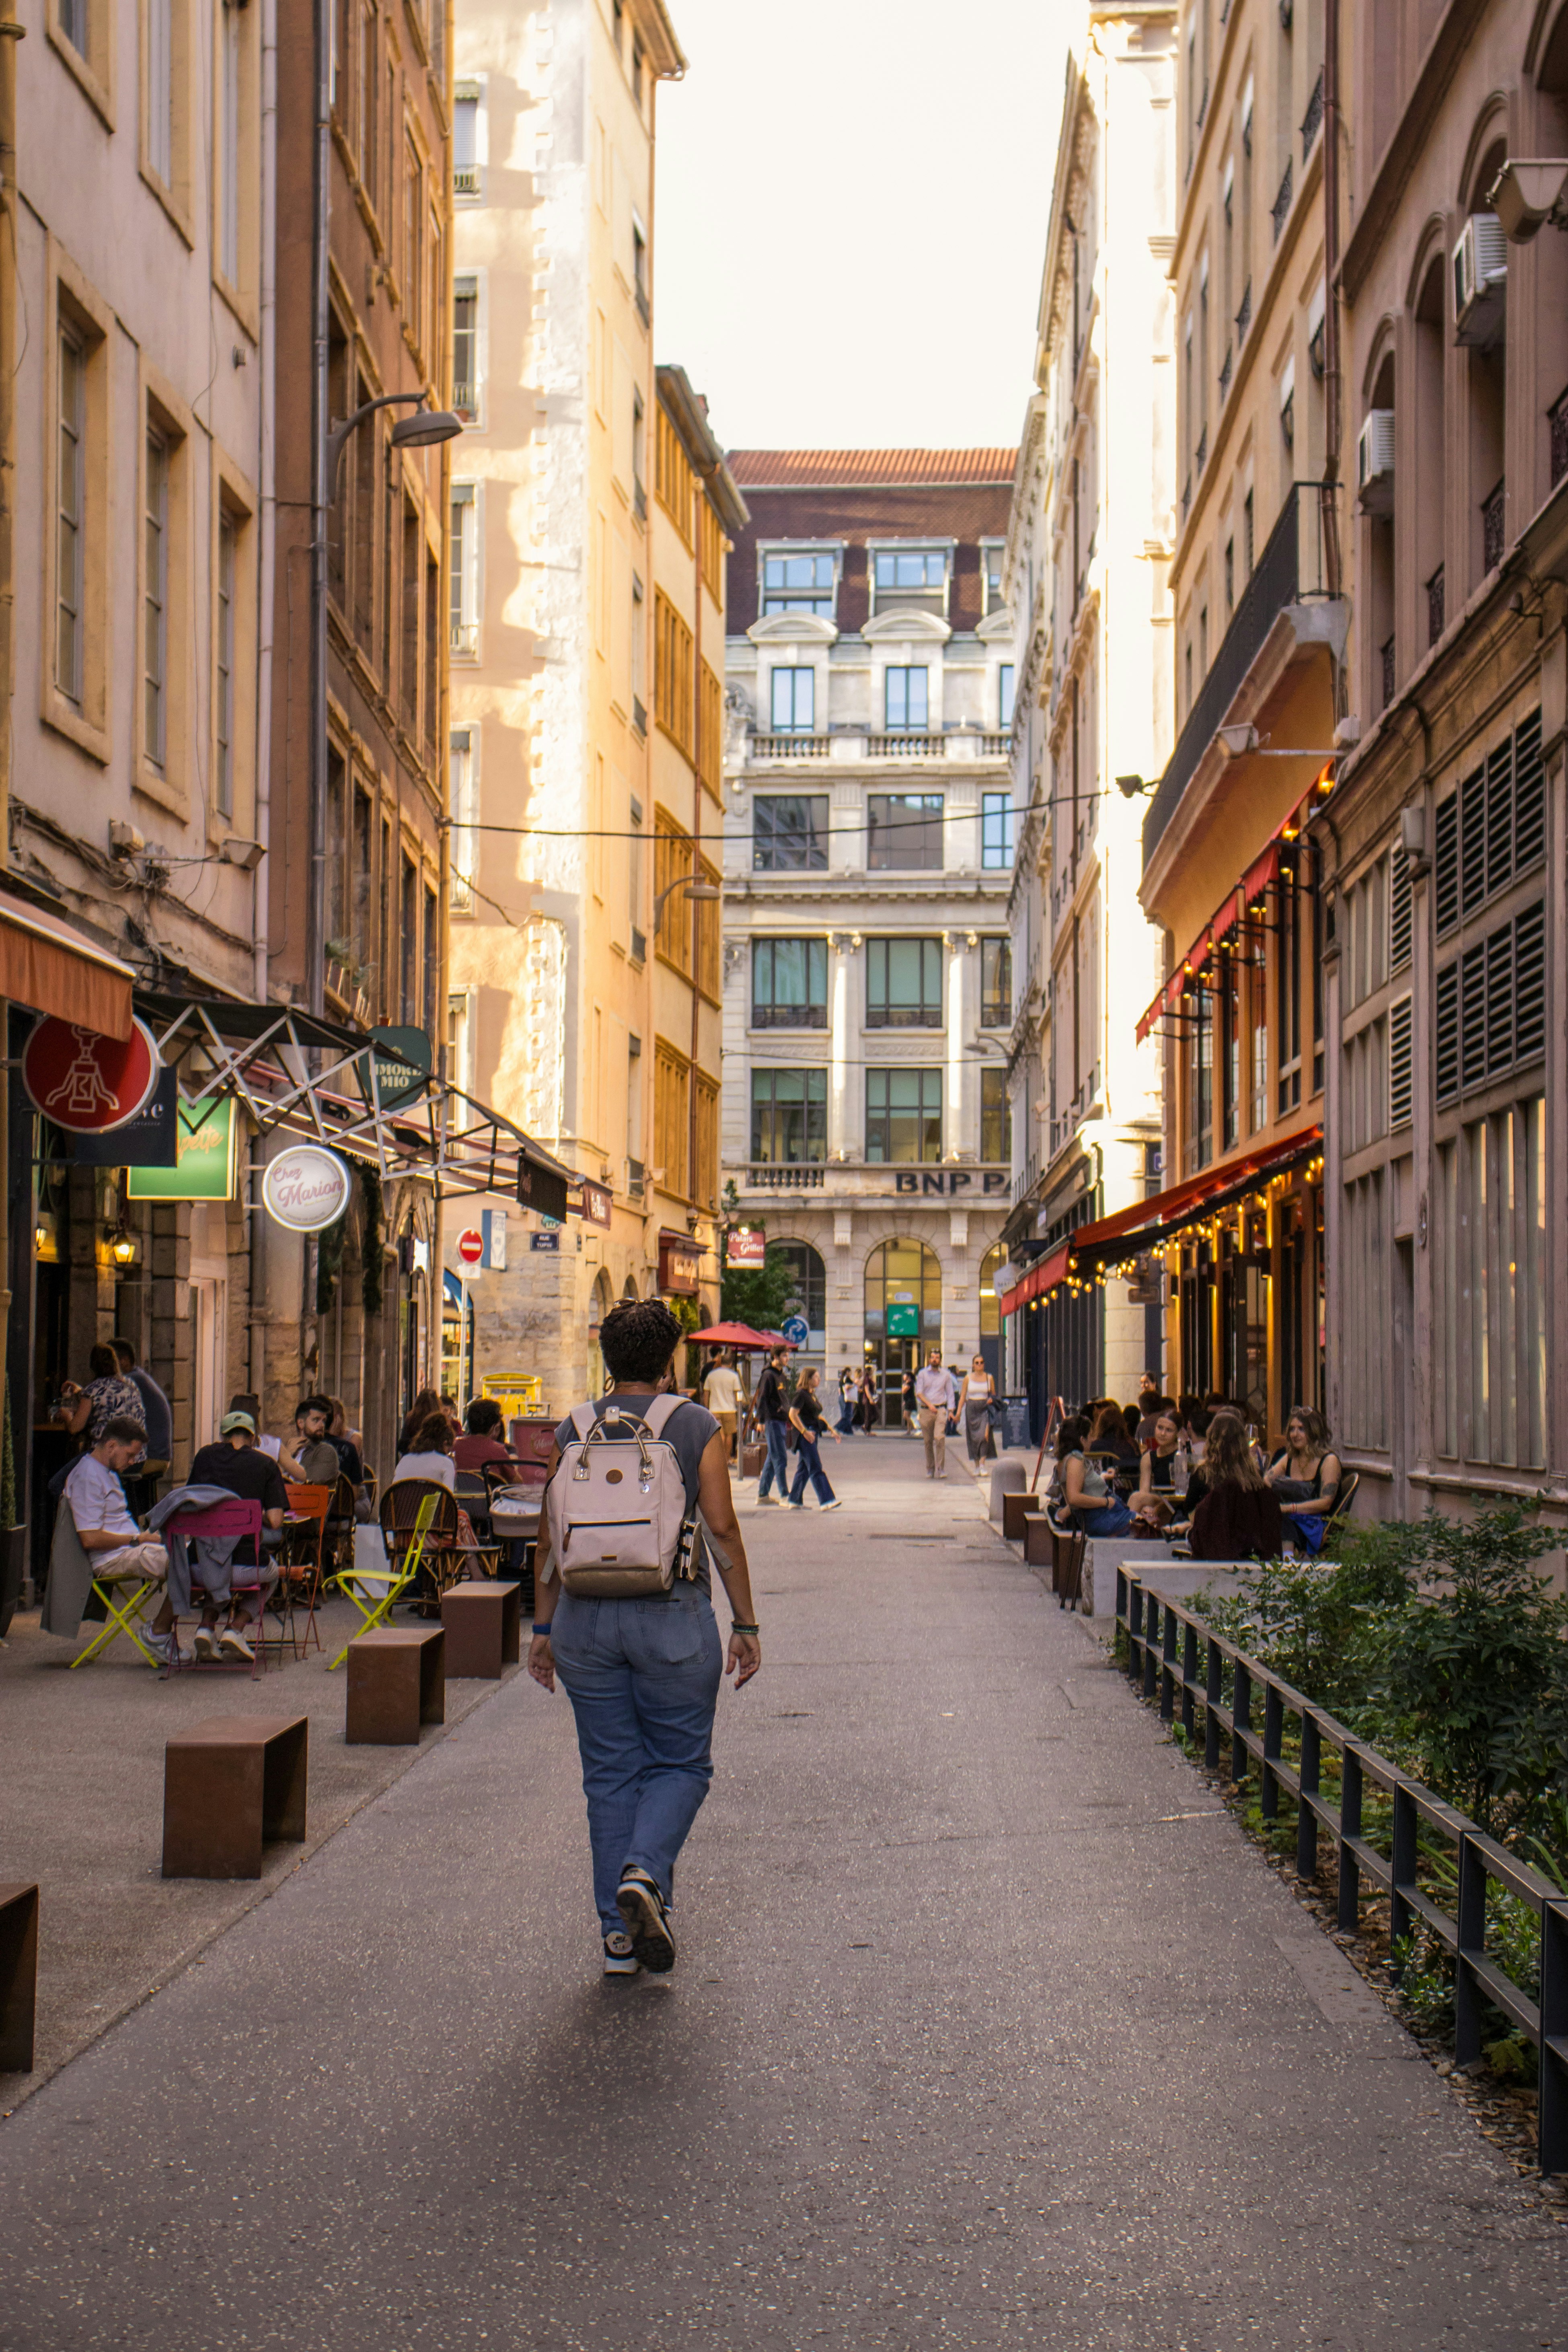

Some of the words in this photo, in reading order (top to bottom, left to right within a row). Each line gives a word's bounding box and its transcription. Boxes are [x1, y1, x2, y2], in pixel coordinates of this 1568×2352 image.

[381, 1075, 409, 1088] MIO
[271, 1167, 302, 1182] Chez
[896, 1173, 971, 1195] BNP
[277, 1180, 344, 1207] Marion
[728, 1232, 753, 1242] Palais
[740, 1242, 764, 1255] Grillet
